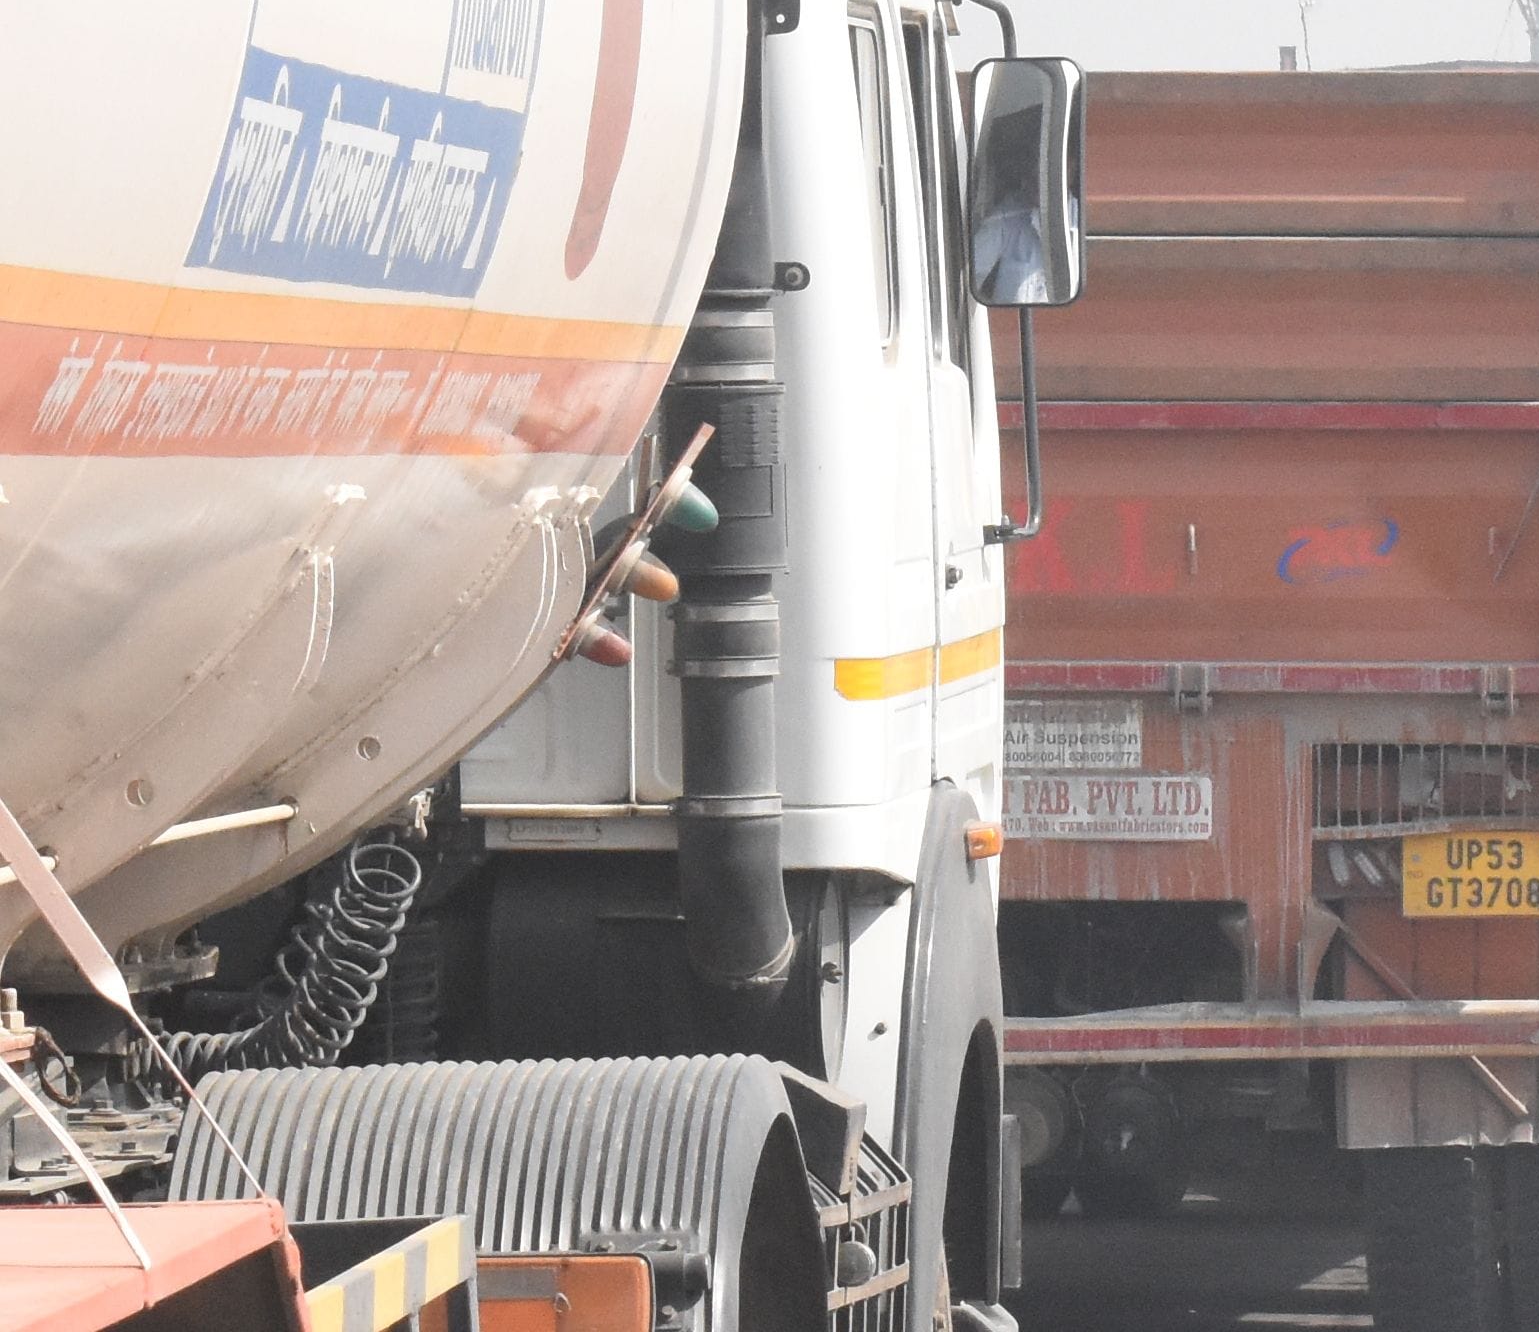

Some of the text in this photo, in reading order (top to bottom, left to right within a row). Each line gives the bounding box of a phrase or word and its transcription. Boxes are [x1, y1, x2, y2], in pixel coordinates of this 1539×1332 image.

[1004, 730, 1139, 747] Air Suspension
[1023, 780, 1078, 816] FAB.
[1087, 780, 1143, 816] PVT.
[1151, 780, 1209, 816] LTD.
[1447, 839, 1523, 870] UP53
